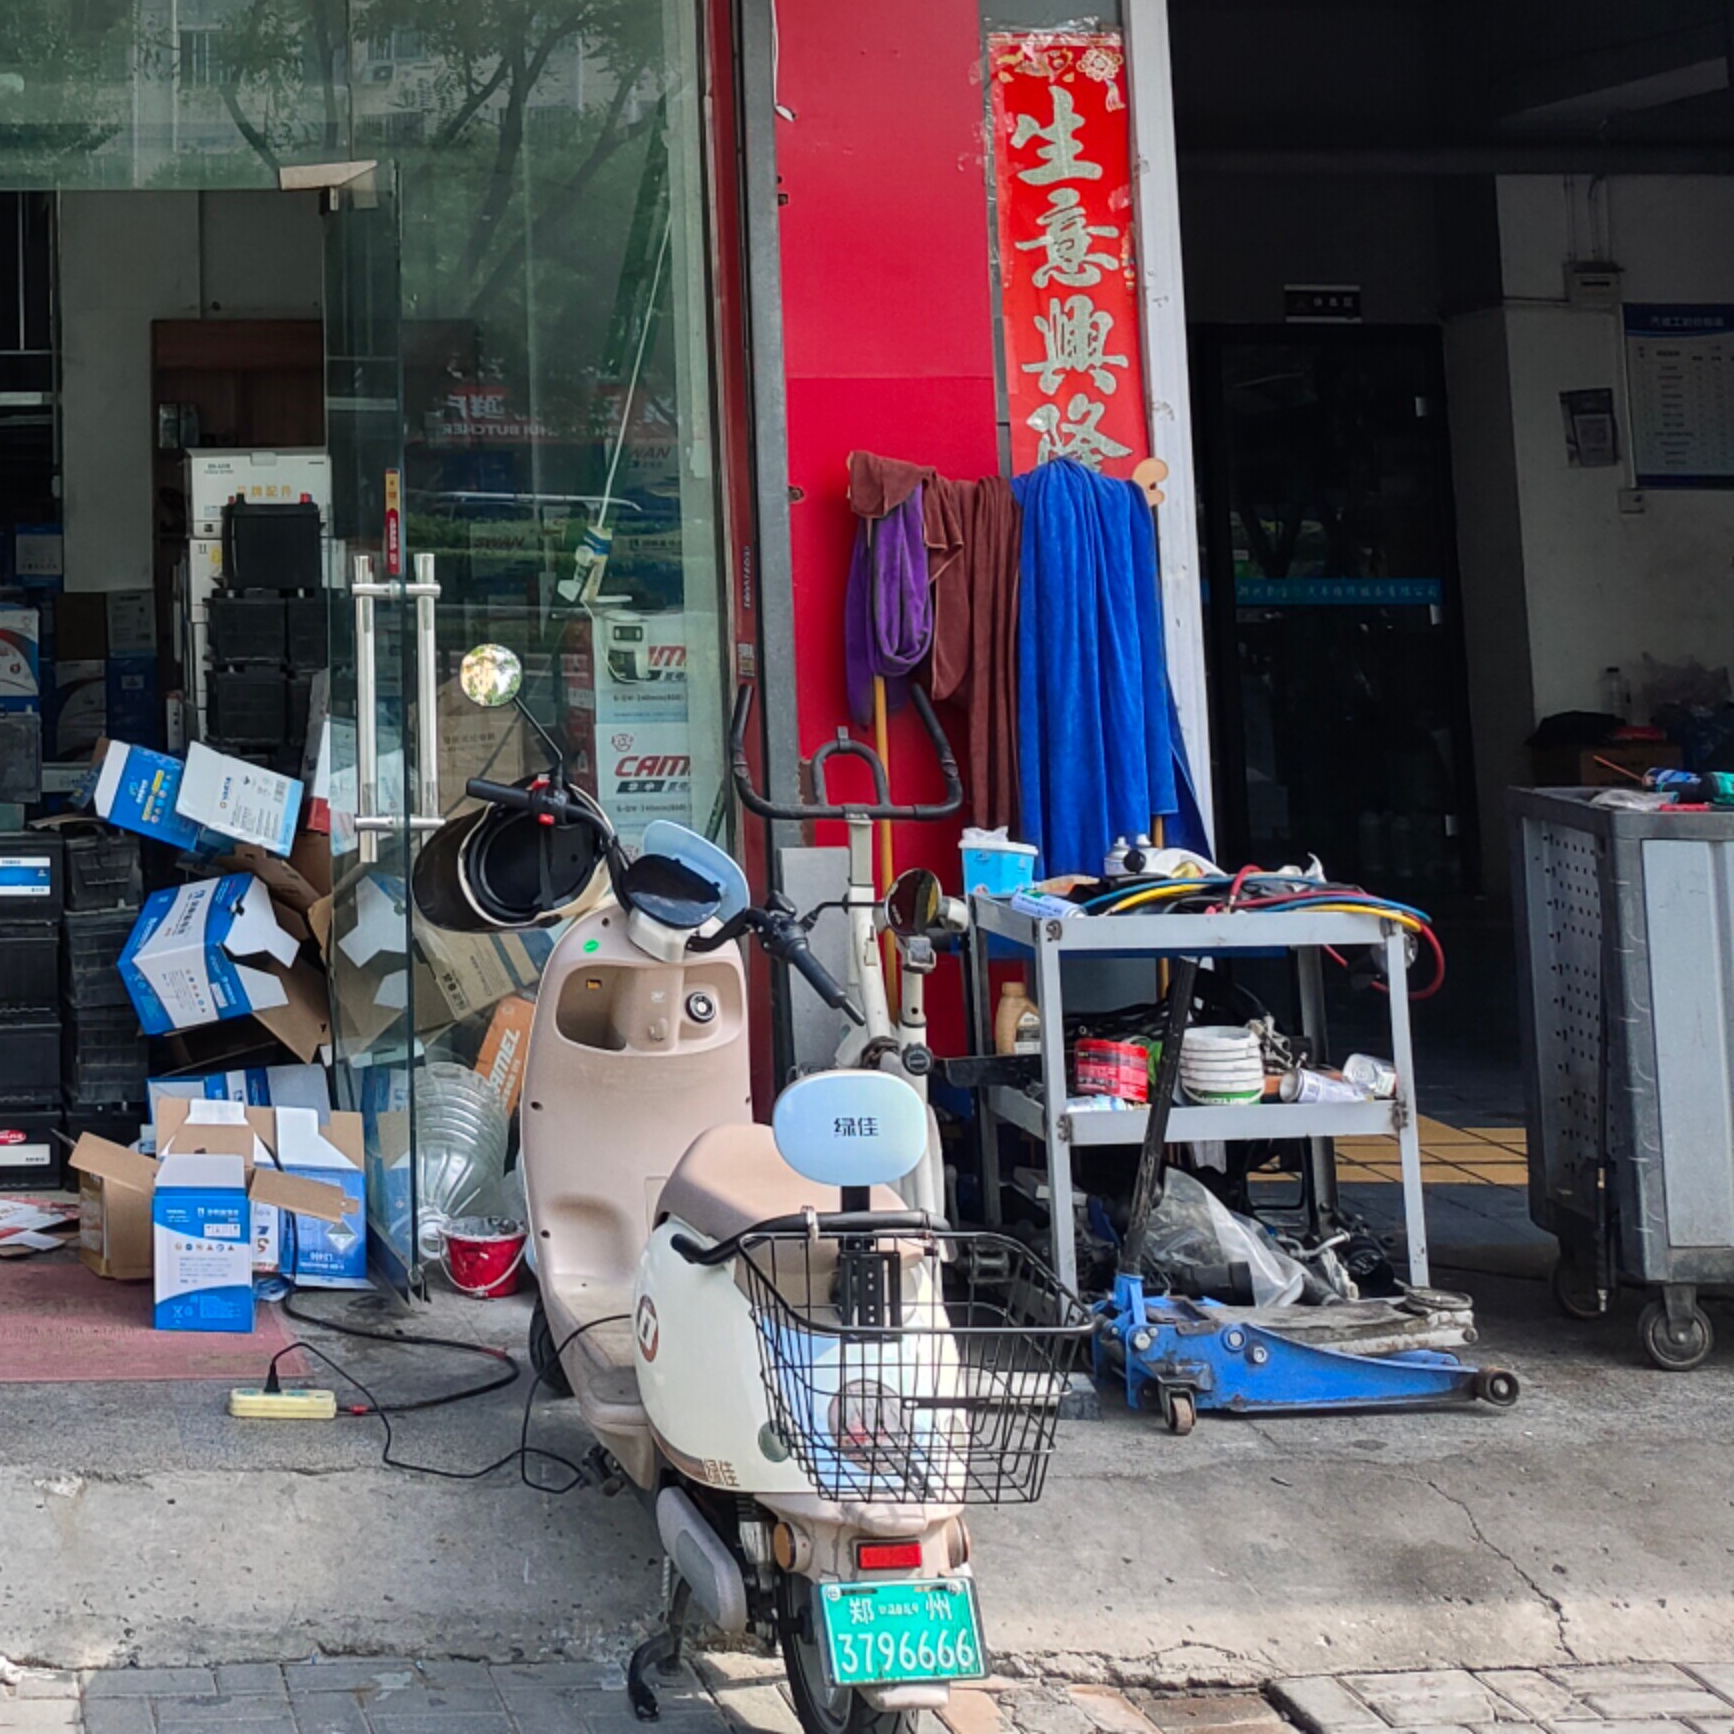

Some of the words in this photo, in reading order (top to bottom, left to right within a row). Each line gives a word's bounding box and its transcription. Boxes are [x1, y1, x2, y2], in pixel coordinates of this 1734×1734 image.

[833, 1116, 880, 1138] 绿佳
[703, 1458, 740, 1487] 绿佳
[849, 1597, 875, 1625] 郑
[925, 1592, 953, 1621] 州
[837, 1628, 975, 1675] 3796666
